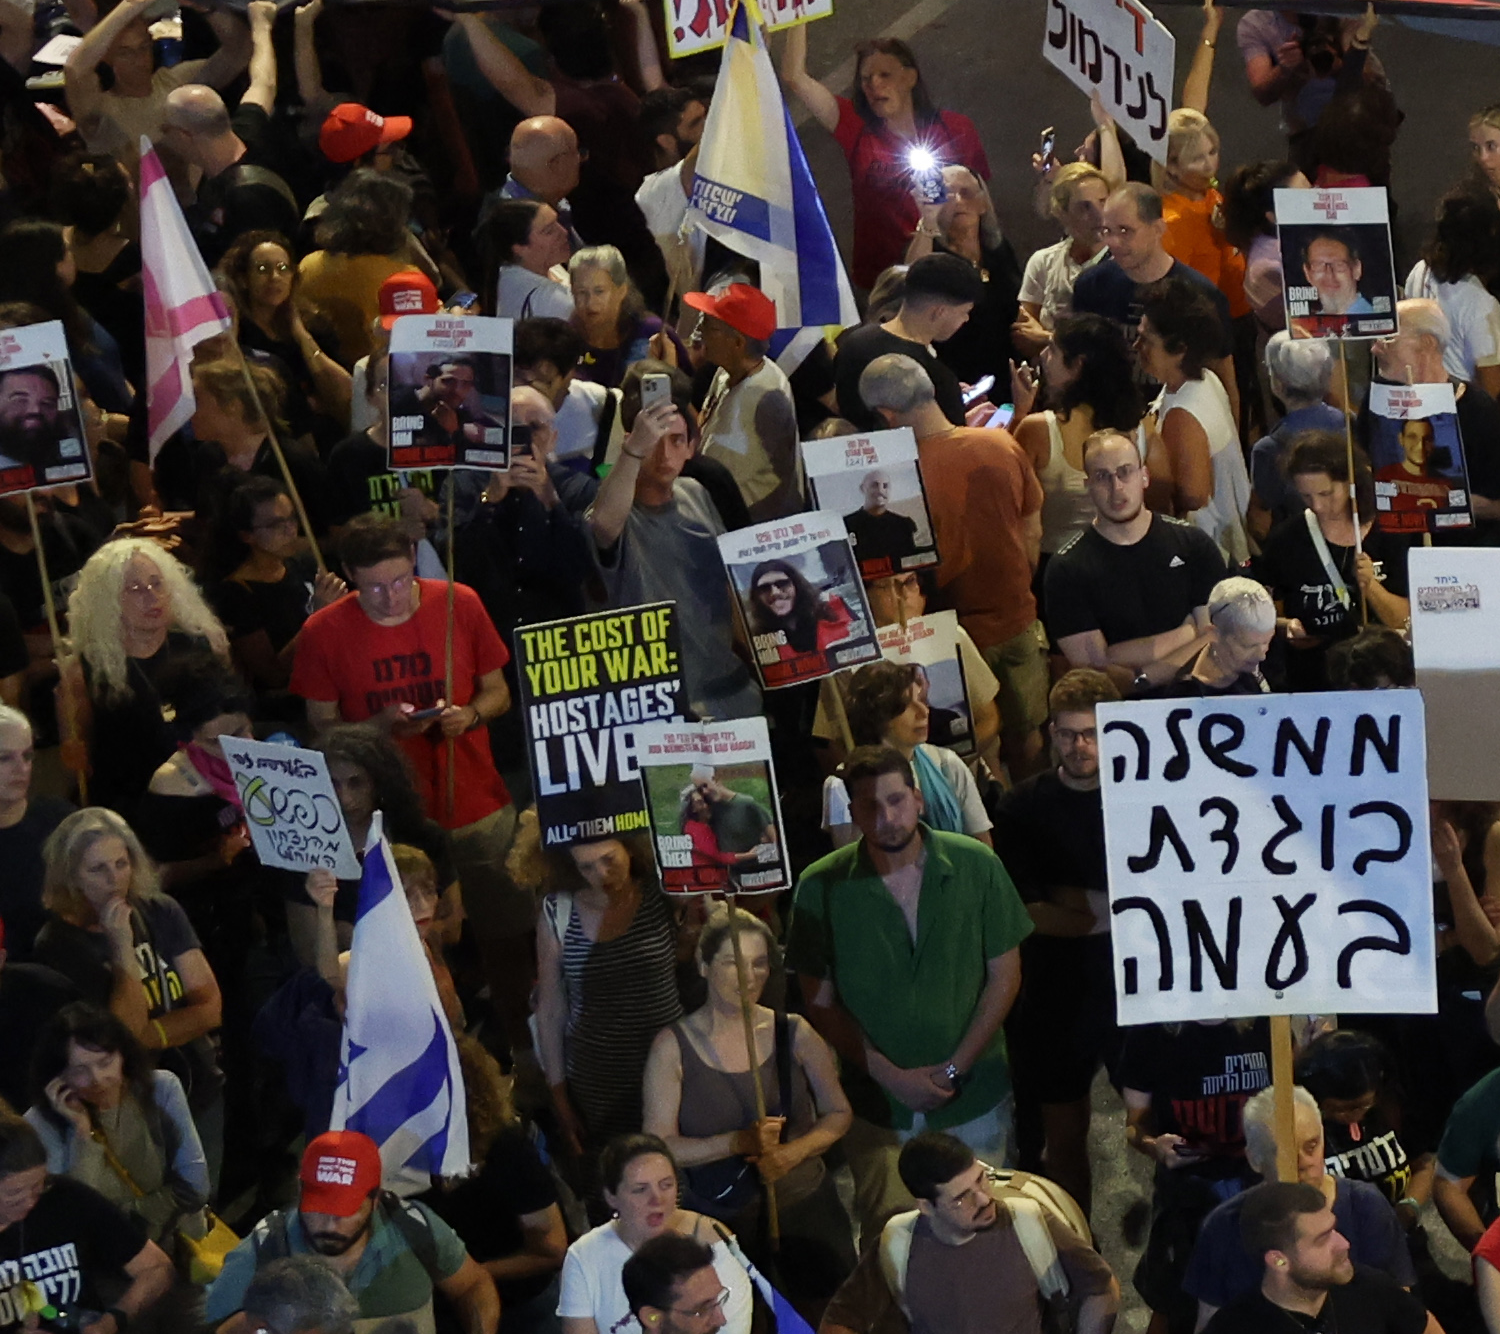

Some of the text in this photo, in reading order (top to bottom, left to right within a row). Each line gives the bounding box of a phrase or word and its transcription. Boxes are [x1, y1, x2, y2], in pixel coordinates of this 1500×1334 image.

[1288, 286, 1319, 302] BRING
[1289, 301, 1309, 316] HIM
[392, 414, 425, 430] BRING
[522, 609, 671, 664] THE COST OF
[526, 647, 679, 697] YOUR WAR:
[1105, 707, 1400, 788] ממשלה
[546, 819, 614, 845] ALL THEM
[656, 834, 693, 852] BRING
[1127, 799, 1412, 879] בוגדת
[1112, 891, 1411, 997] בעמה
